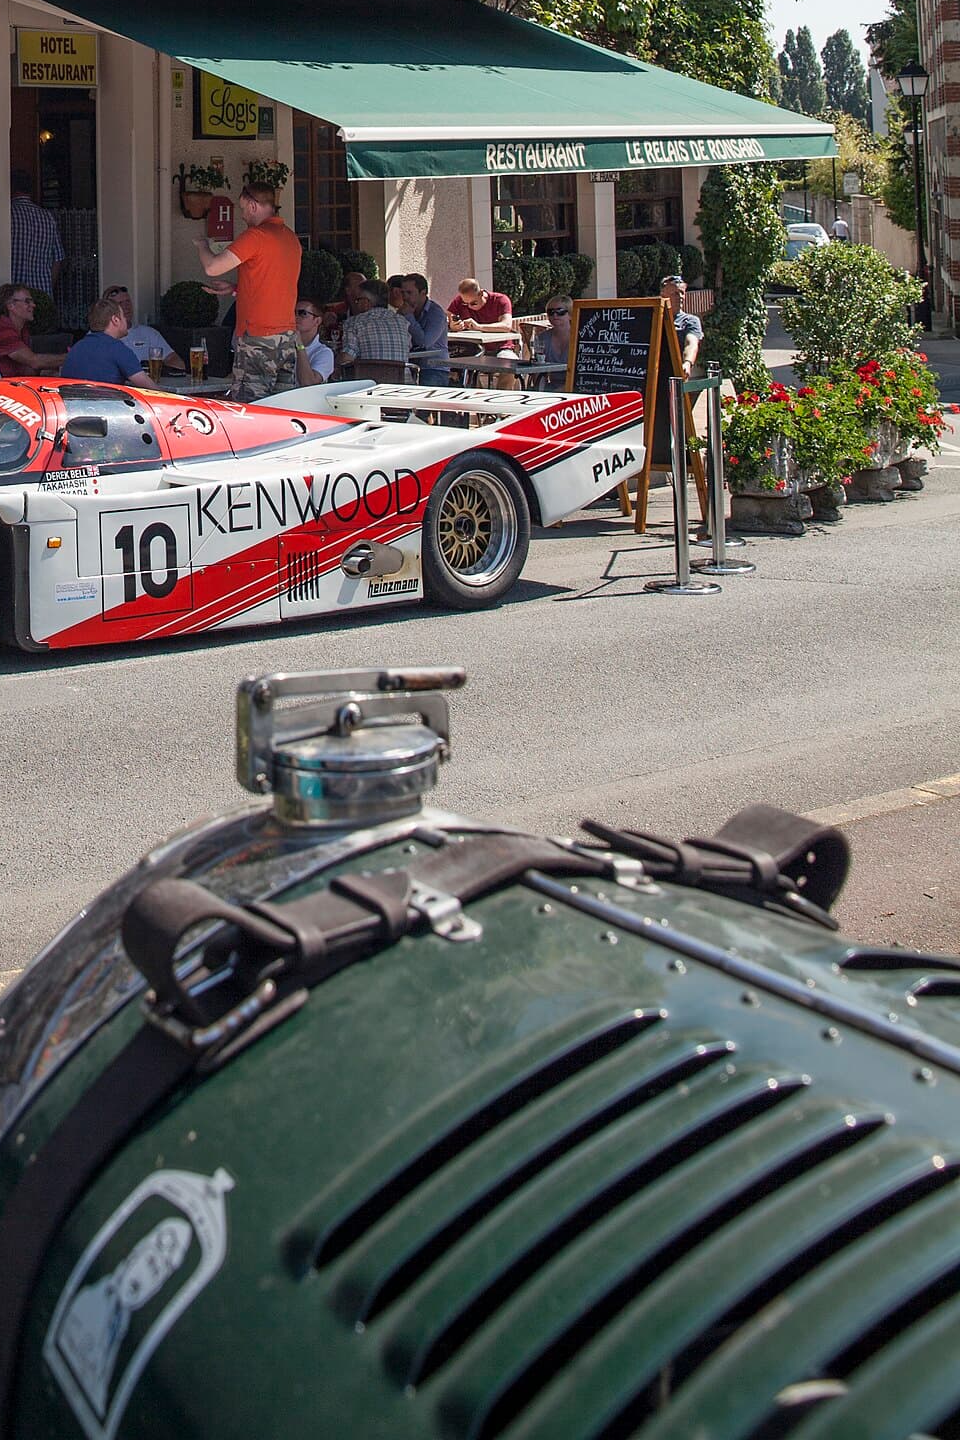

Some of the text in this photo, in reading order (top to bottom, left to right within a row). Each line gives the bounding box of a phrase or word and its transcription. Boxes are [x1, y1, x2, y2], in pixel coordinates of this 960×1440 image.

[40, 36, 77, 55] HOTEL
[22, 62, 95, 81] RESTAURANT
[208, 86, 257, 132] Logis
[486, 137, 765, 170] RESTAURANT LE RELAIS DE RONSARD
[219, 205, 230, 222] H
[602, 308, 636, 321] HOTEL
[609, 321, 620, 331] DE
[598, 329, 630, 344] FRANCE
[540, 395, 611, 433] YOKOHAMA
[46, 468, 88, 482] DEREK BELL
[591, 447, 636, 484] PIAA
[42, 479, 88, 492] TAKAHASHI
[196, 467, 422, 537] KENWOOD
[114, 522, 178, 603] 10
[367, 577, 419, 597] heinzmann
